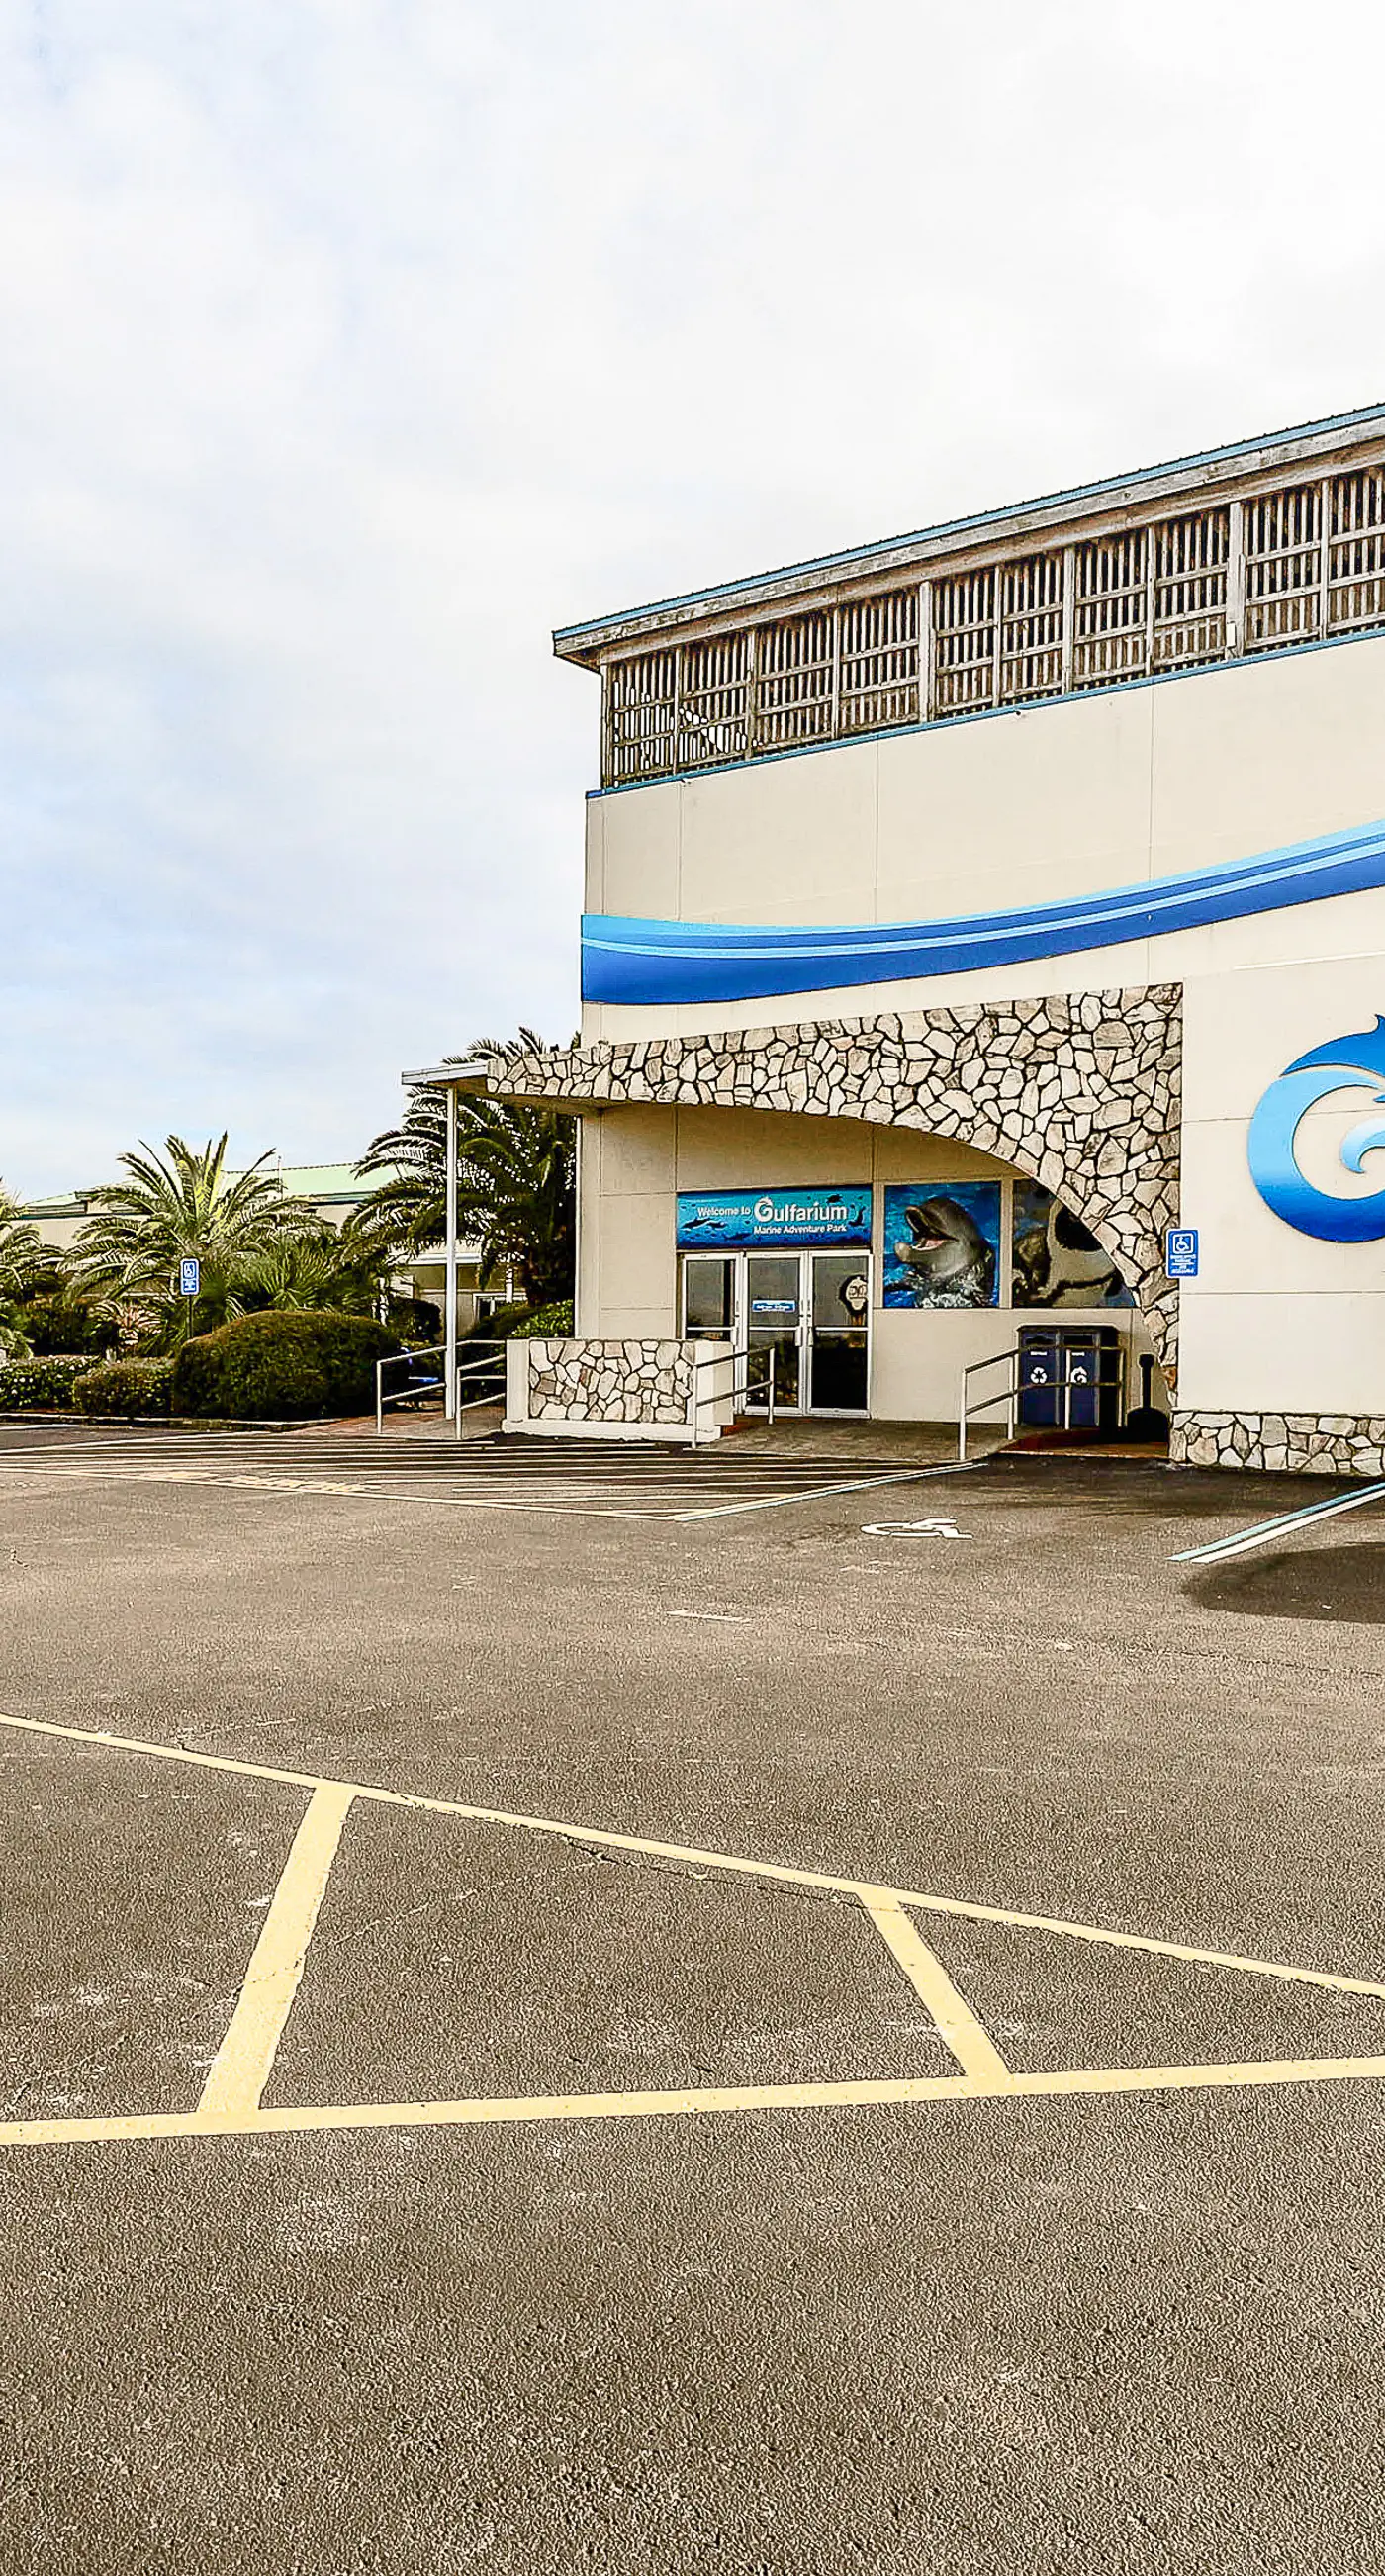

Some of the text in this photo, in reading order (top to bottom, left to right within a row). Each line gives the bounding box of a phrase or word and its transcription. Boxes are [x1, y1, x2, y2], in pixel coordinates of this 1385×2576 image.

[697, 1196, 848, 1223] Welcome to Gulfarium
[753, 1223, 848, 1235] Marine Adventure Park
